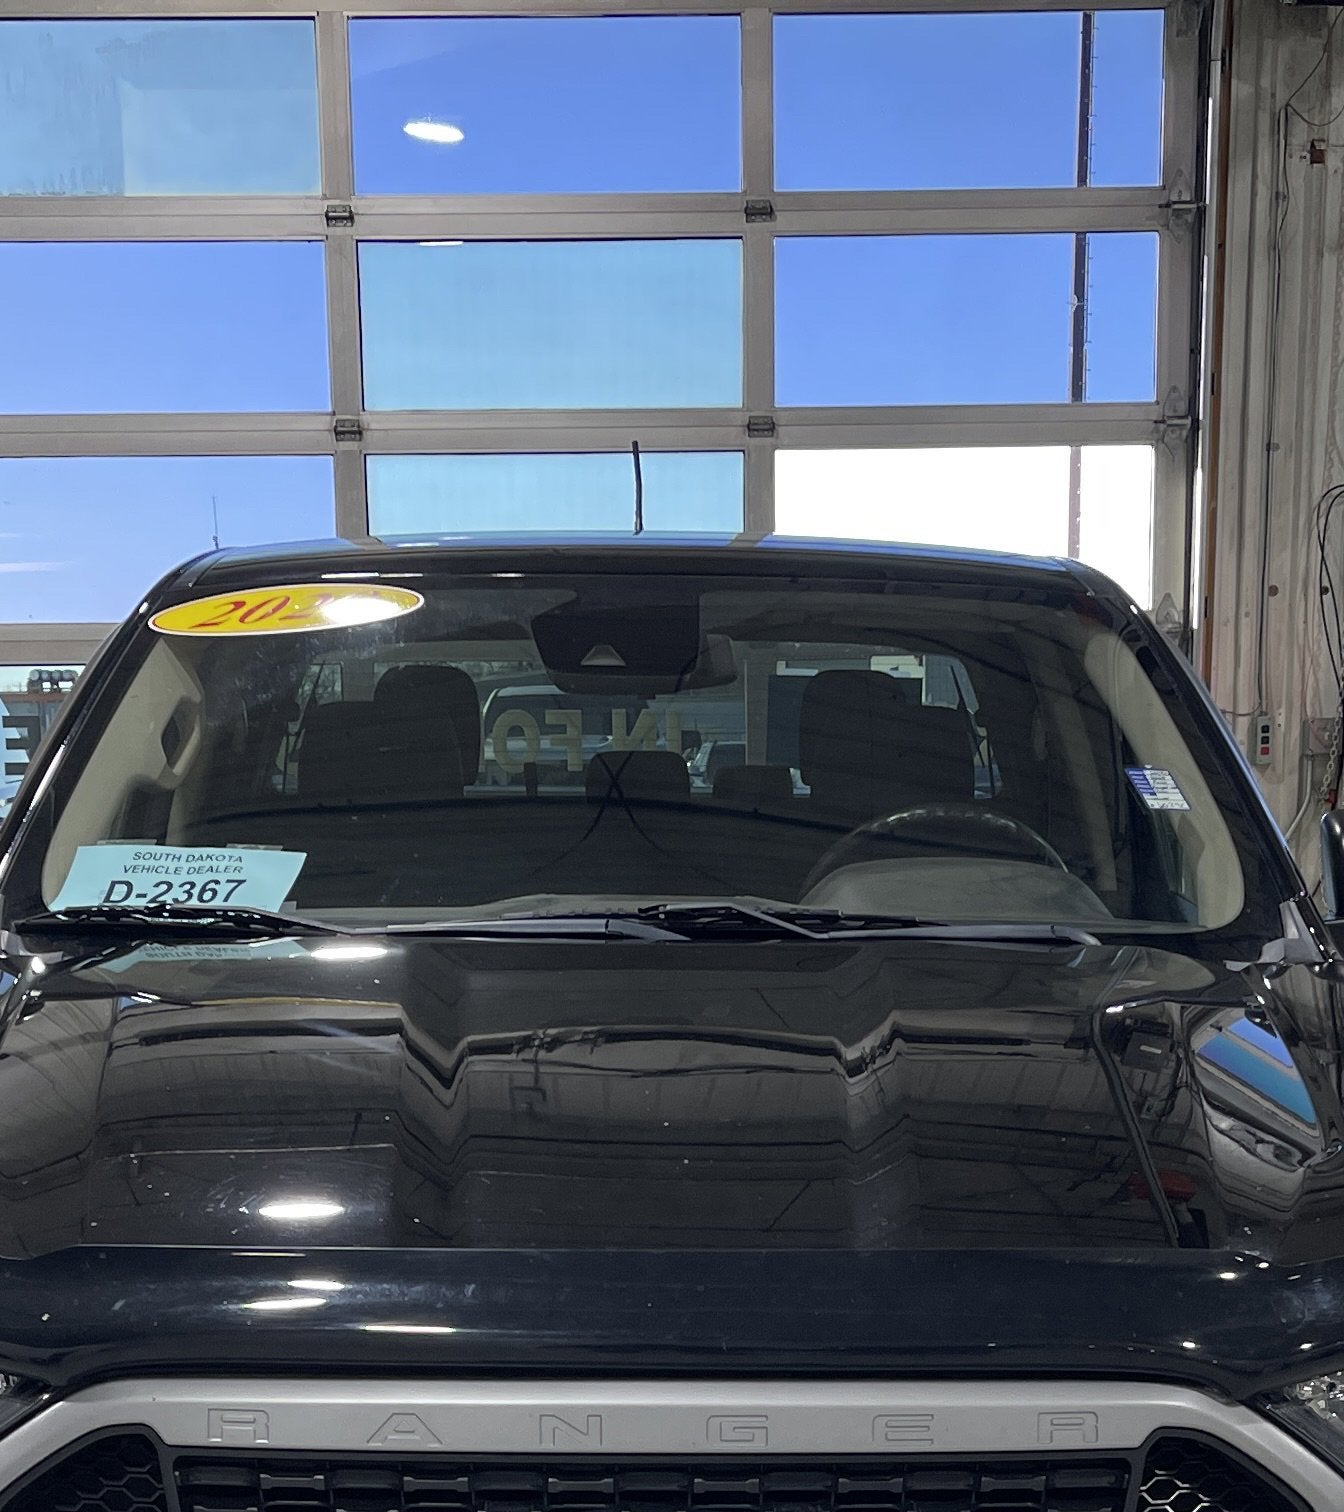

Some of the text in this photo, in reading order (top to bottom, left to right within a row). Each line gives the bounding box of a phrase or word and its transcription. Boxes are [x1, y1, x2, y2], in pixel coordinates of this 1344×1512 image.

[132, 851, 243, 863] SOUTH DAKOTA
[122, 864, 244, 875] VEHICLE DEALER
[104, 878, 247, 904] D-2367
[207, 1408, 1099, 1447] RANGER
